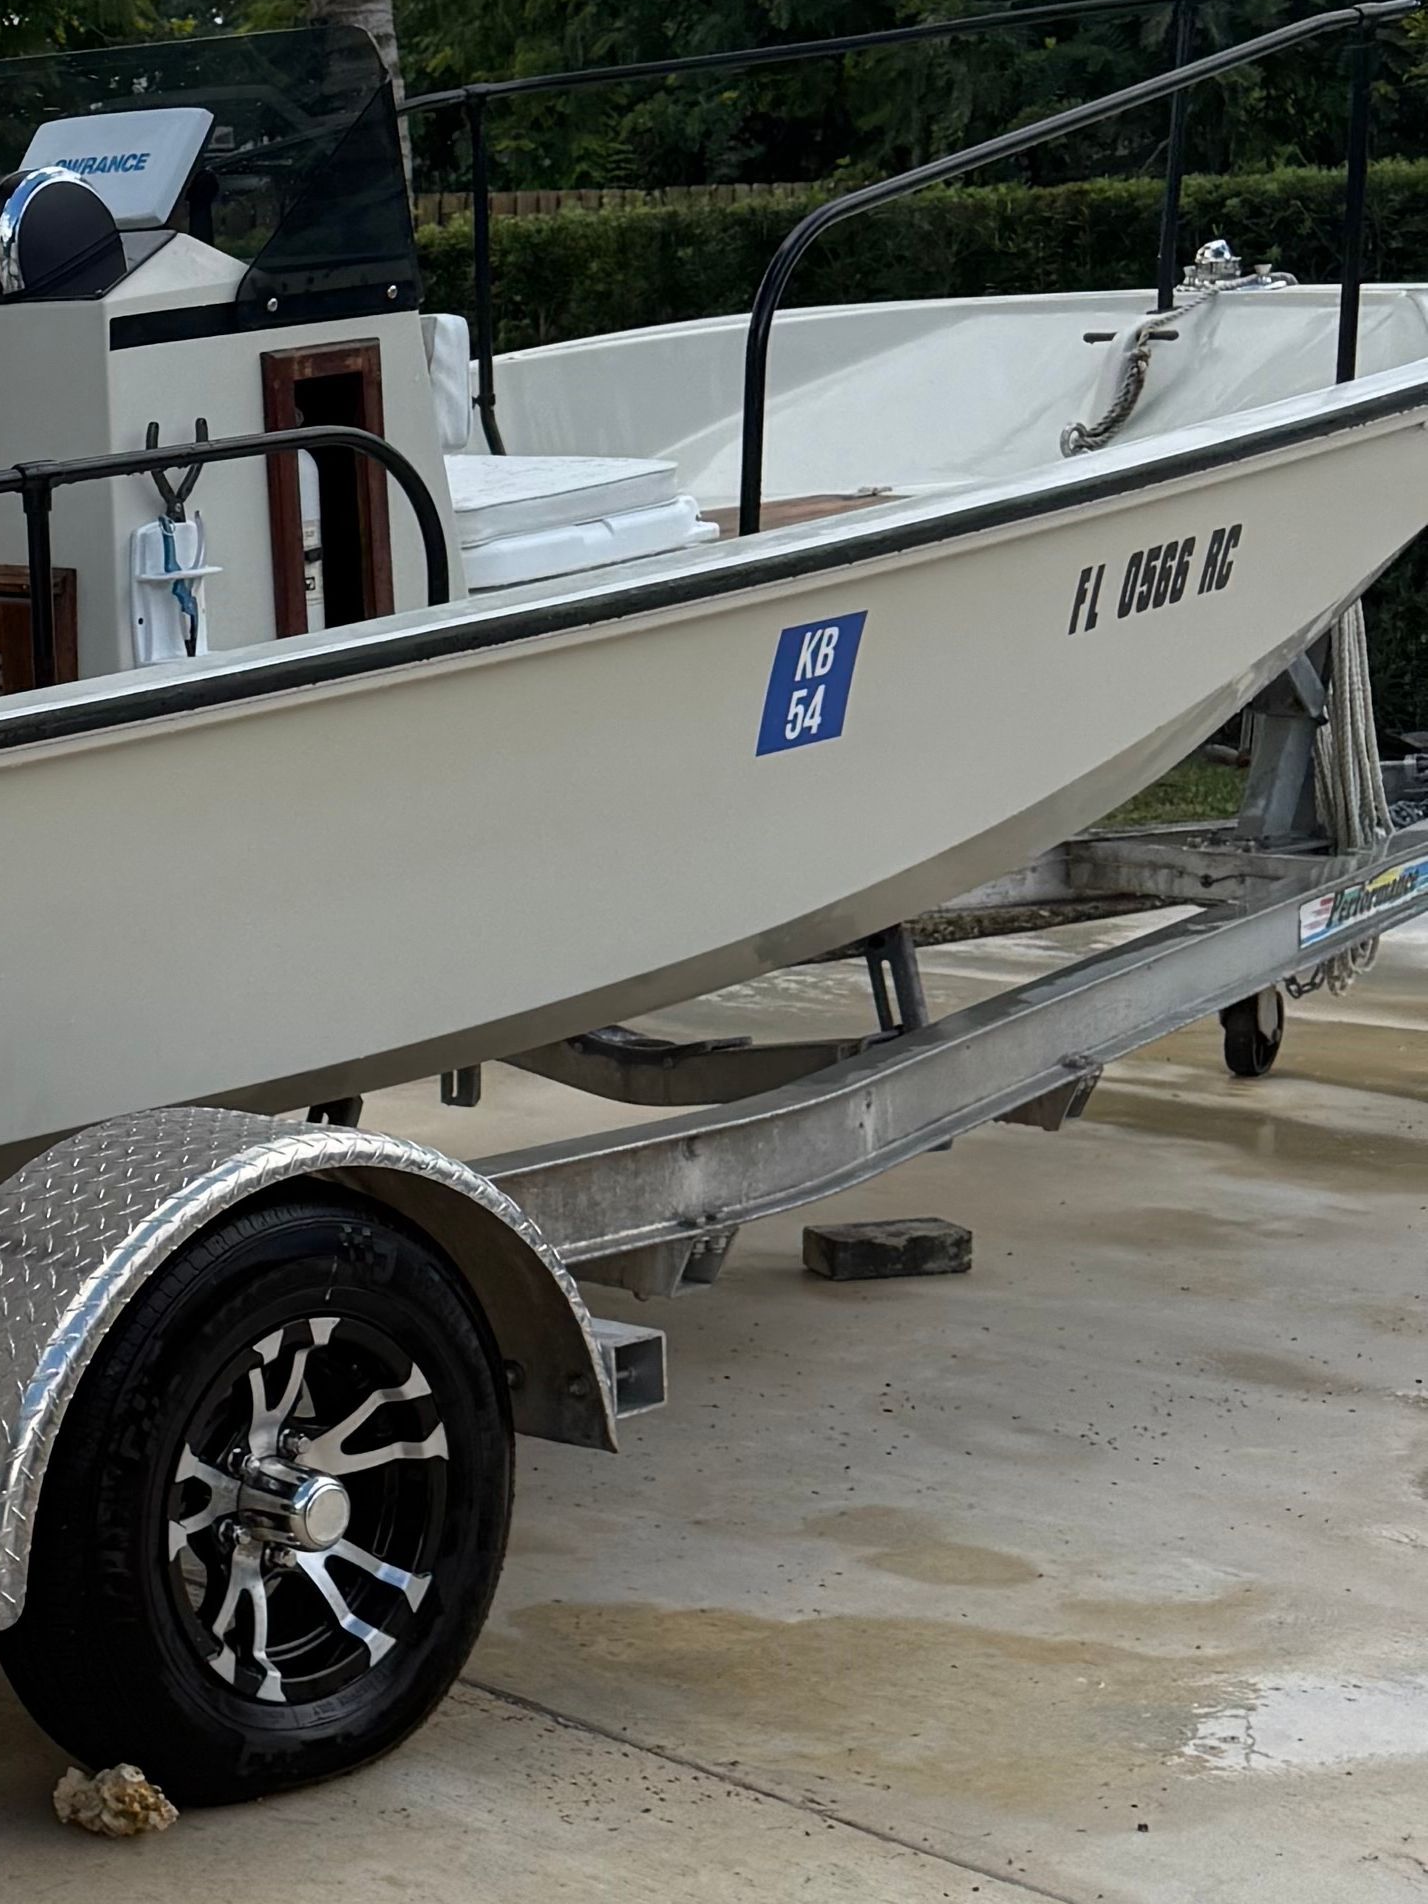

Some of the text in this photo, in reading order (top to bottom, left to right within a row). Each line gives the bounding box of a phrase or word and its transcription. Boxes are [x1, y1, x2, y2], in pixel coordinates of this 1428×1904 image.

[53, 153, 151, 176] OWRANCE
[1068, 523, 1243, 635] FL 0566 RC
[785, 626, 840, 740] KB 54
